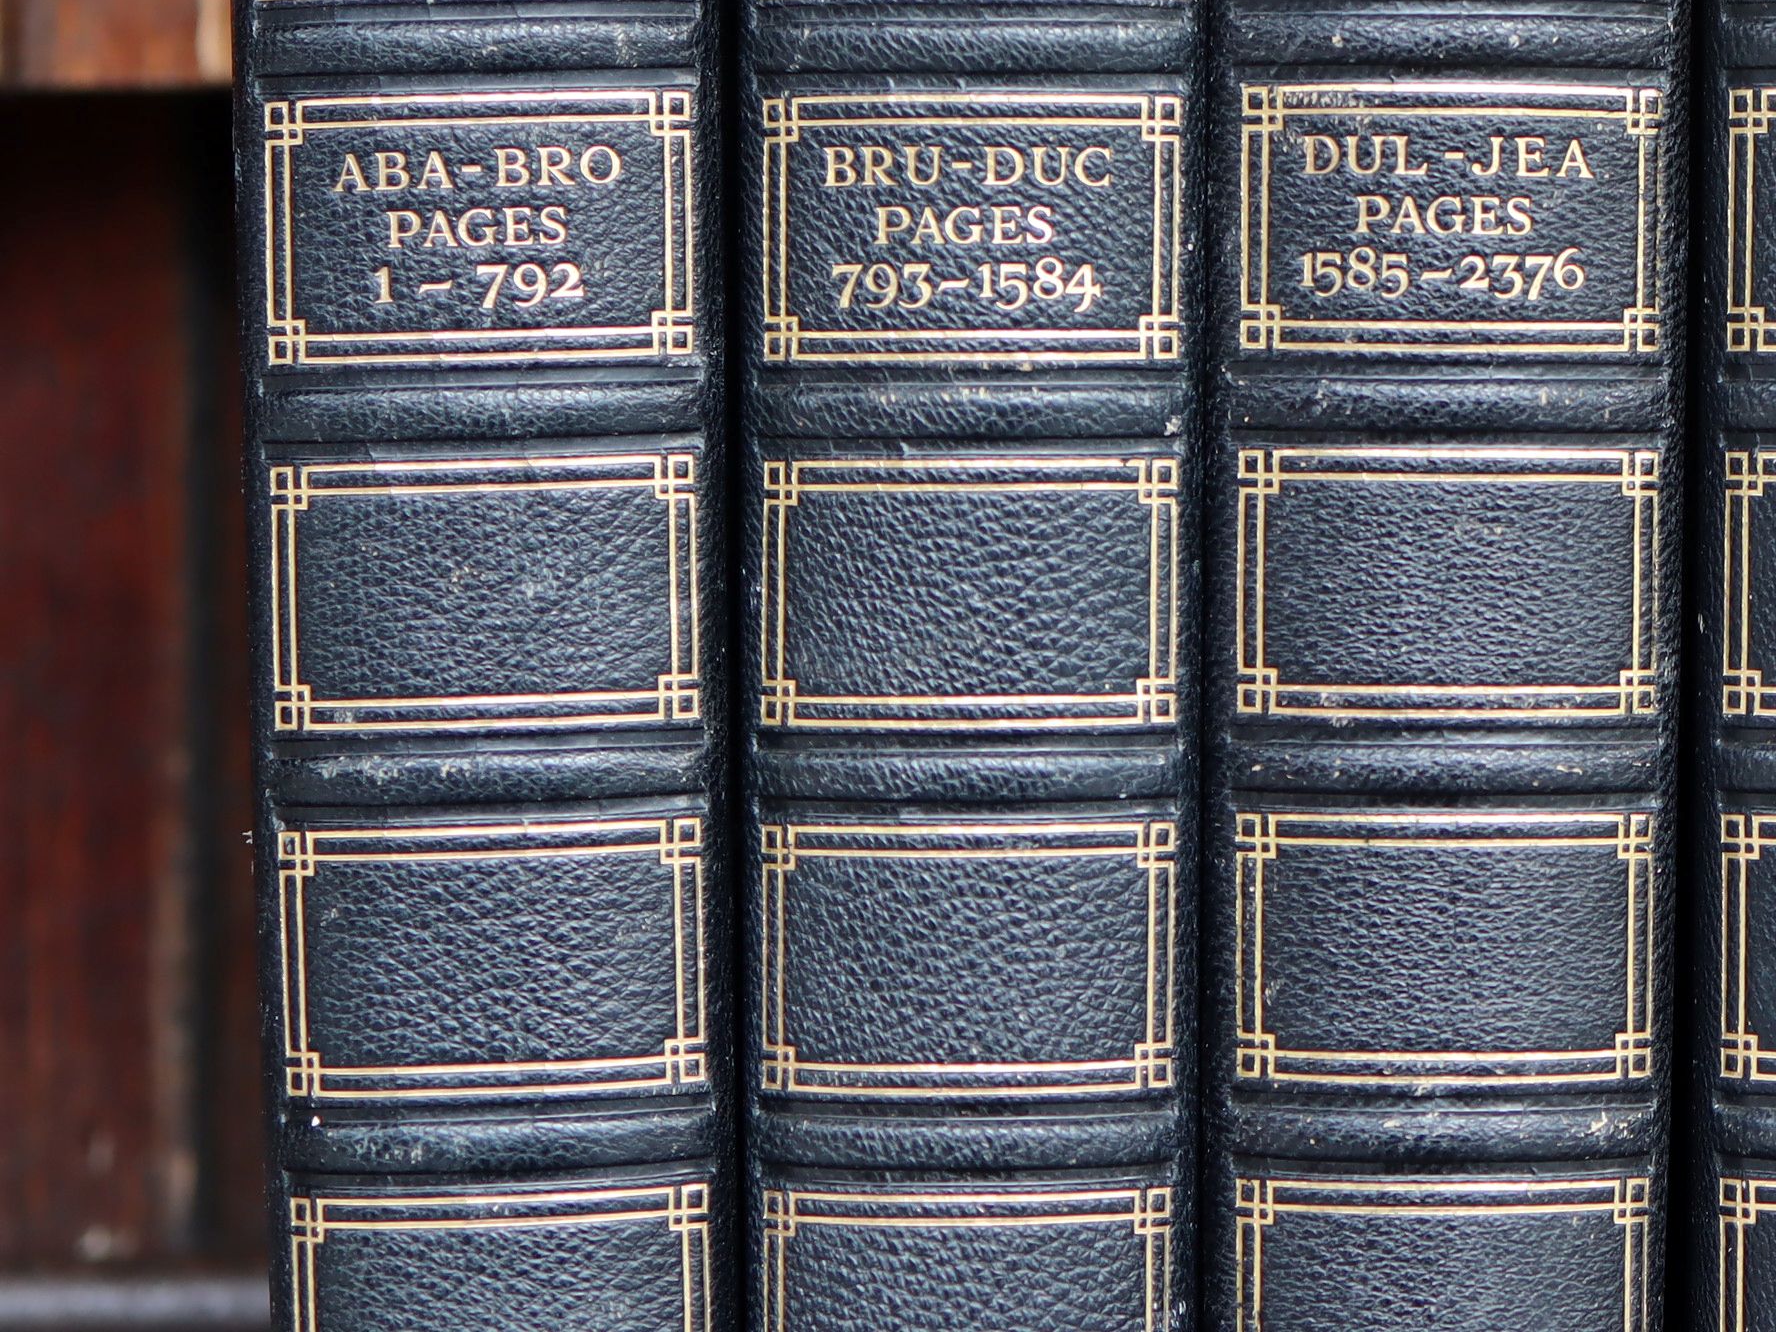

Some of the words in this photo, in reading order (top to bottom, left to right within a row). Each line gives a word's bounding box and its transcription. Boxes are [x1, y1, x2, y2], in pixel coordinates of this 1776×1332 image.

[333, 145, 623, 193] ABA-BRO
[822, 145, 1113, 188] BRU-DUC
[1301, 134, 1595, 180] DUL-JEA
[386, 206, 568, 250] PAGES
[873, 205, 1055, 246] PAGES
[1355, 194, 1534, 236] PAGES
